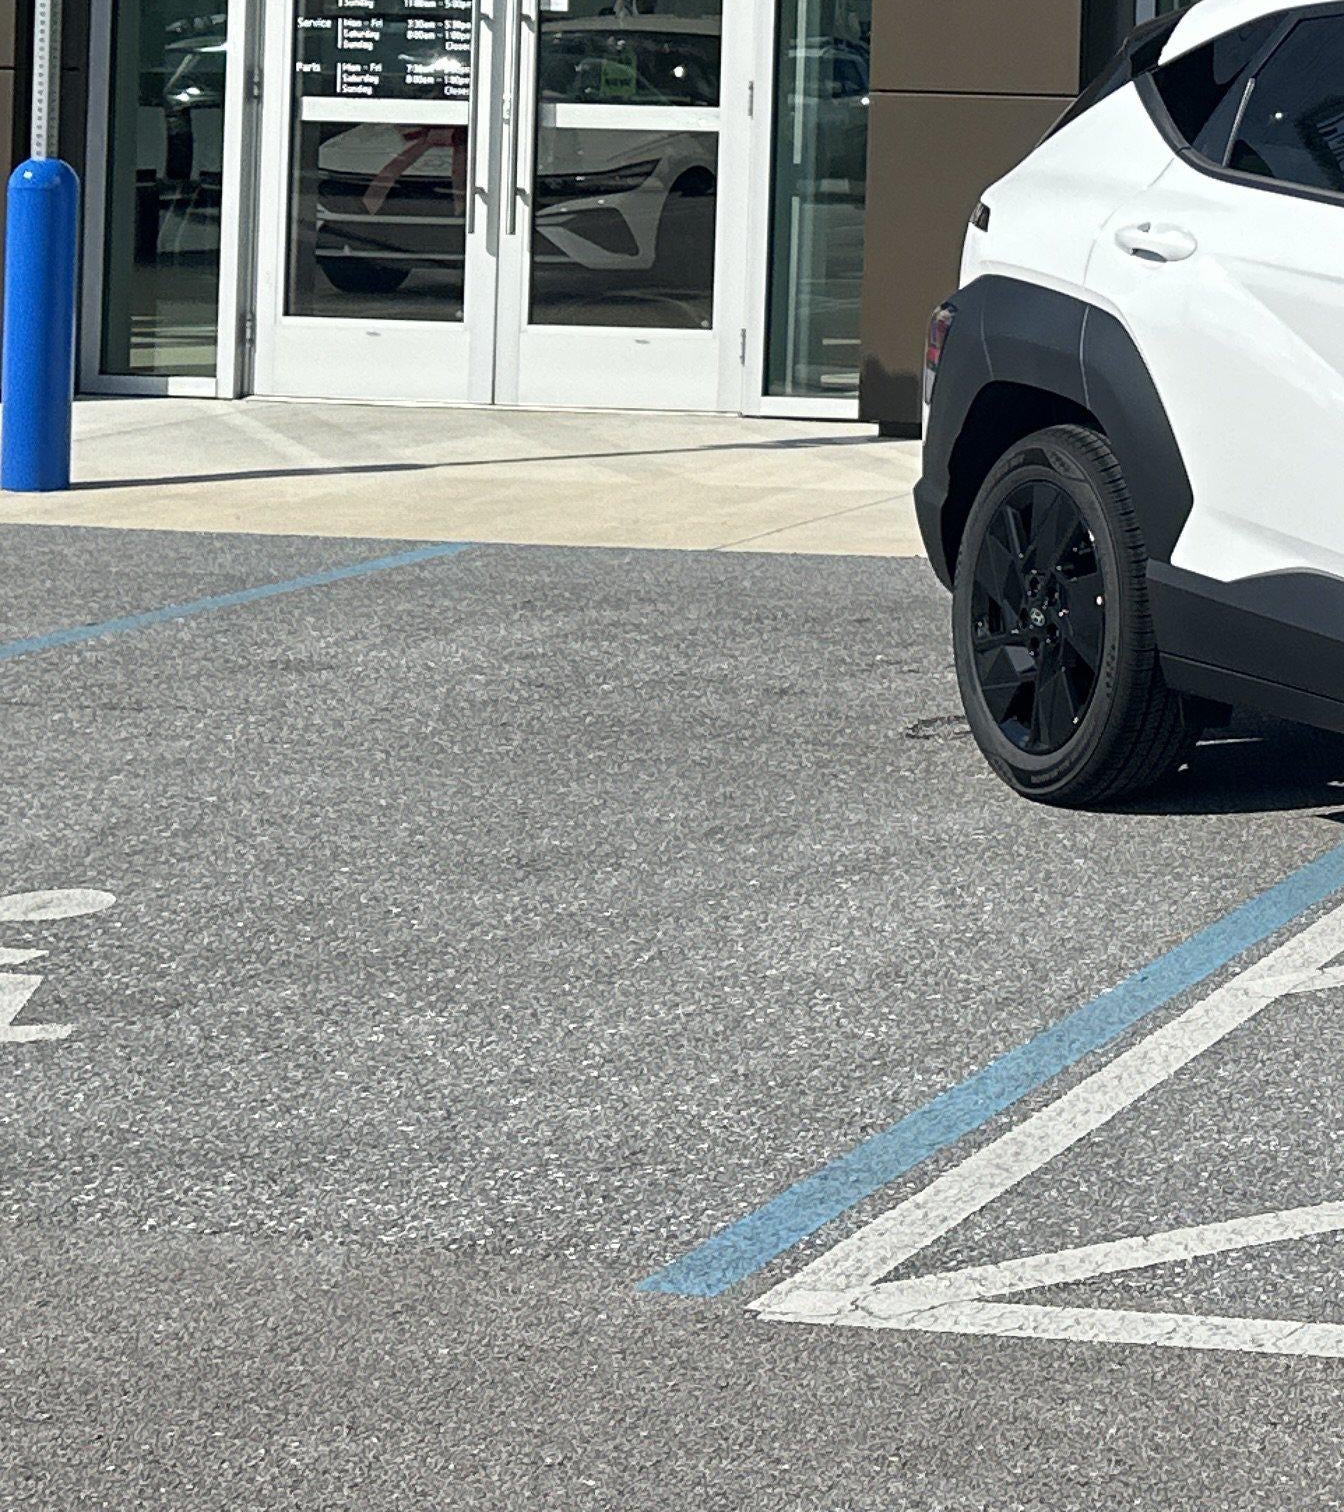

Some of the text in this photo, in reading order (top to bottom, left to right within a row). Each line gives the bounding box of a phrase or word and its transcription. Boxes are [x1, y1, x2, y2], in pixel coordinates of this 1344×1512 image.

[297, 16, 332, 28] Service
[343, 29, 381, 41] Saturday
[343, 40, 374, 51] Sunday
[296, 61, 321, 73] Parts
[342, 73, 380, 85] Saturday
[342, 83, 373, 96] Sunday
